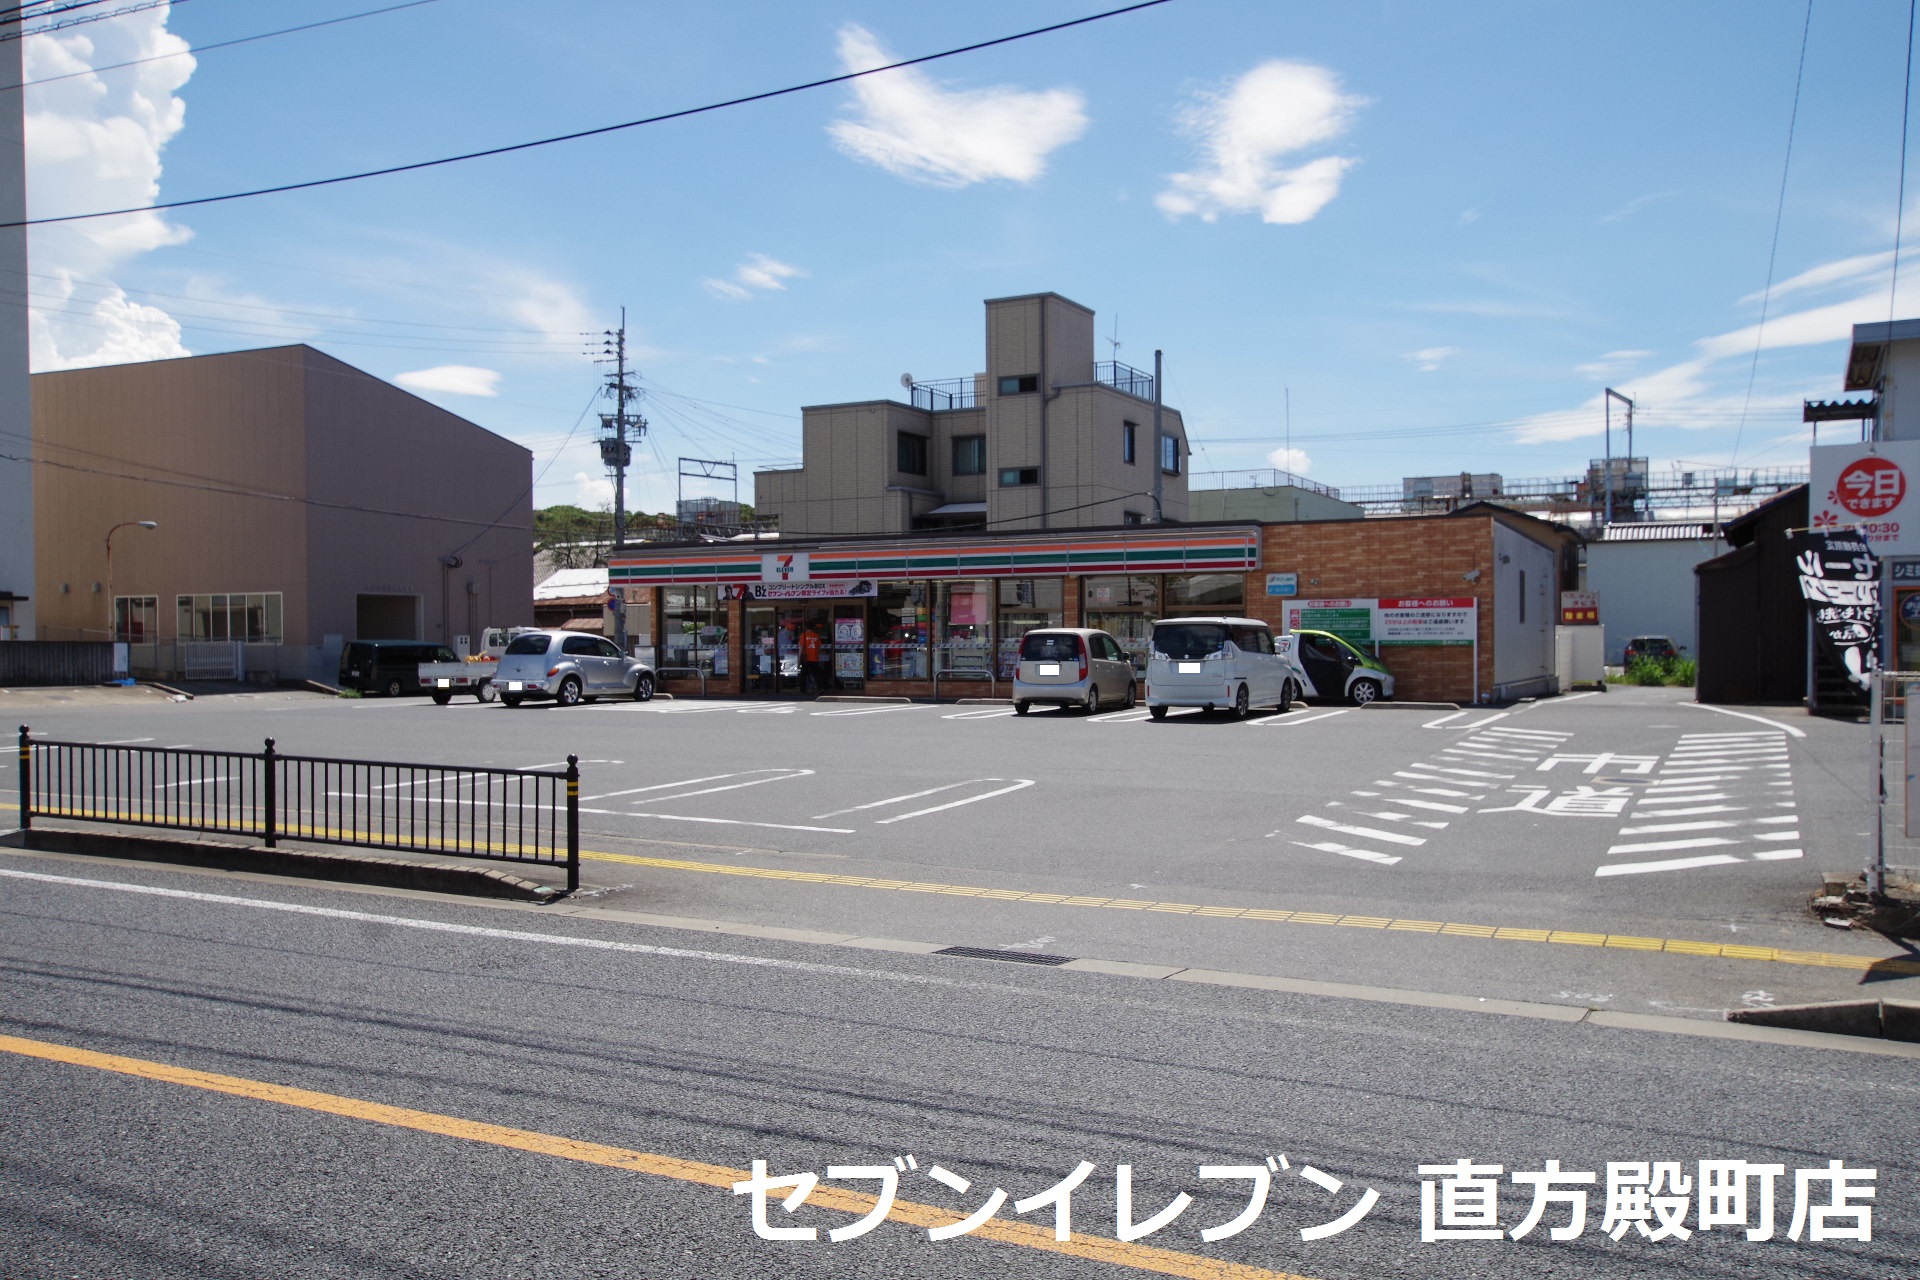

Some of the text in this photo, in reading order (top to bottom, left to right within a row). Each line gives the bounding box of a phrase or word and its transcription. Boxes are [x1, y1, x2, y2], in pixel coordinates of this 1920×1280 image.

[1843, 469, 1900, 497] 今日
[1847, 497, 1896, 510] できます
[1397, 599, 1454, 608] お客様へのお願い
